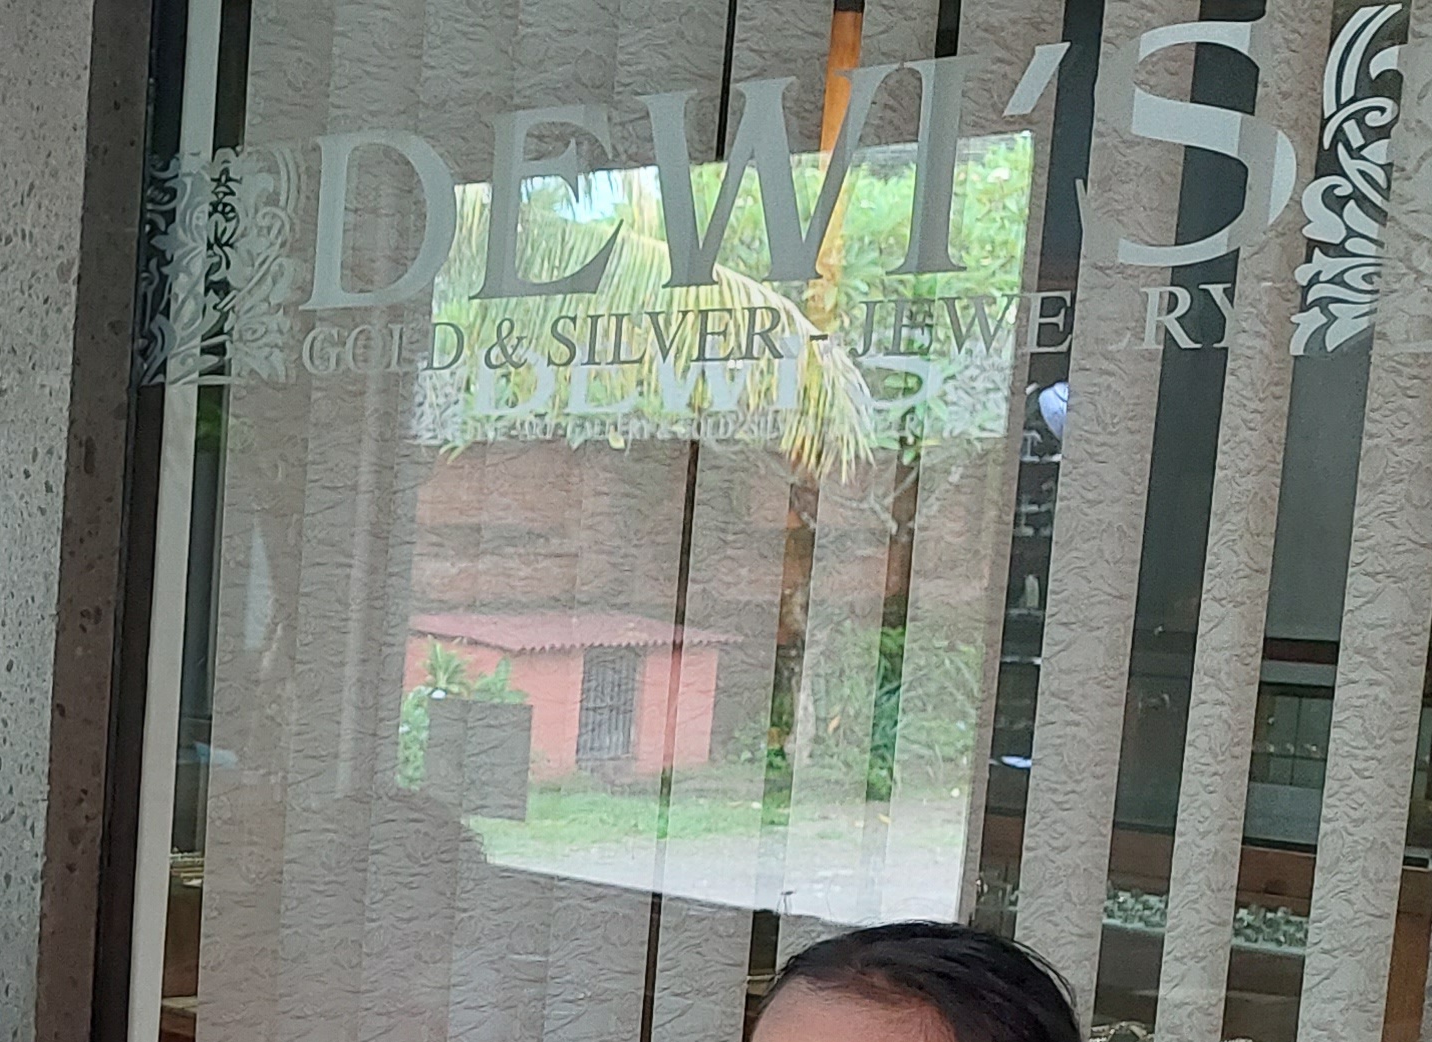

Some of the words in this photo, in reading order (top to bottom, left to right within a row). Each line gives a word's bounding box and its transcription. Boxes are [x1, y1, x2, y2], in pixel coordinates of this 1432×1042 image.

[299, 19, 1298, 313] DEWI'S
[301, 320, 466, 376] GOLD
[483, 317, 528, 370] &
[546, 303, 785, 368] SILVER
[851, 279, 1271, 359] JEWERY
